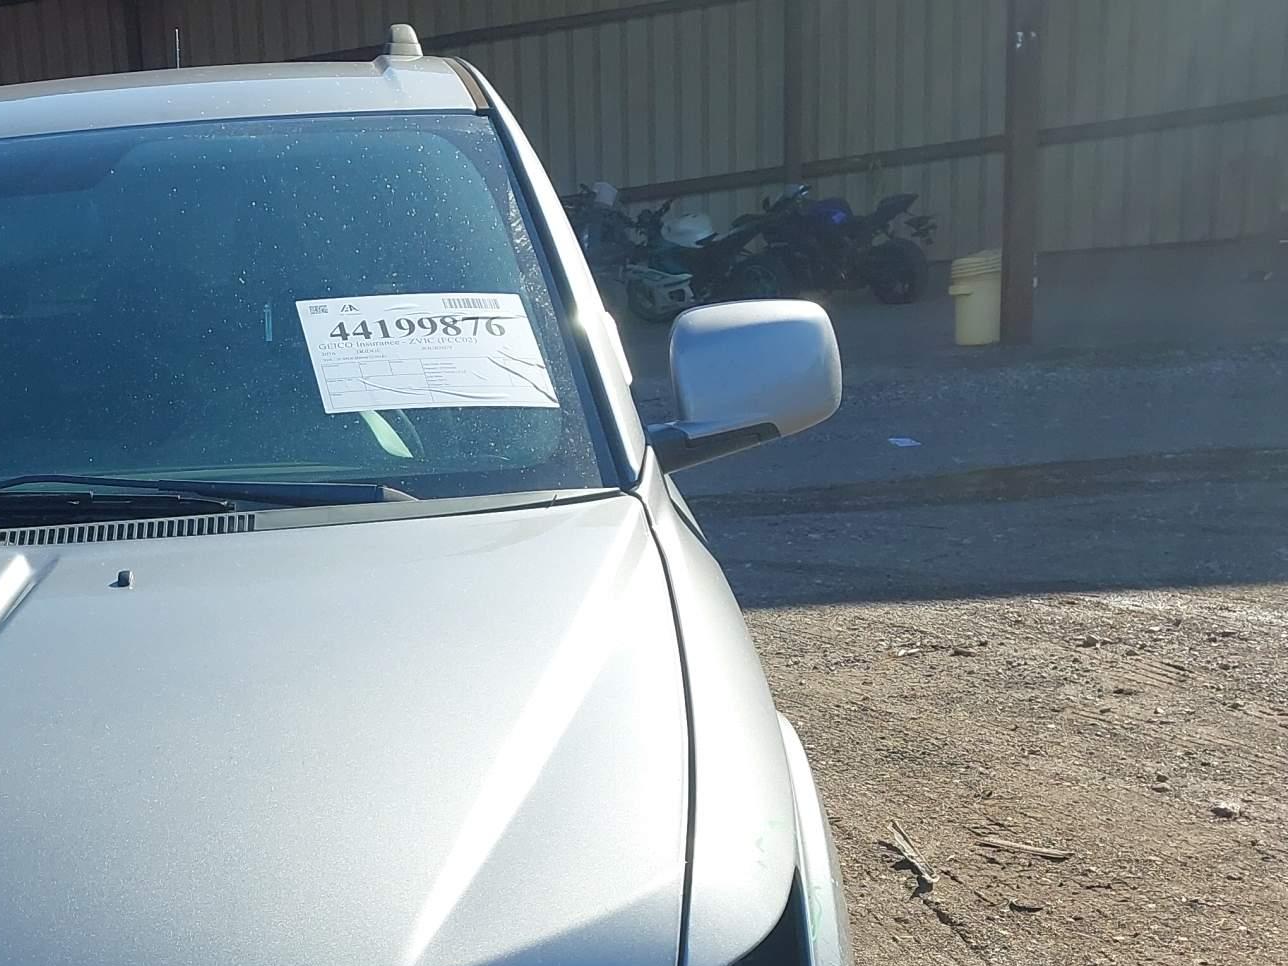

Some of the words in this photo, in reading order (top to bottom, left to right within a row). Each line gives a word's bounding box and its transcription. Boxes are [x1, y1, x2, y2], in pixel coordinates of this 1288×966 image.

[329, 316, 506, 340] 44199876
[318, 341, 353, 350] GEICO
[356, 340, 400, 348] Insurance
